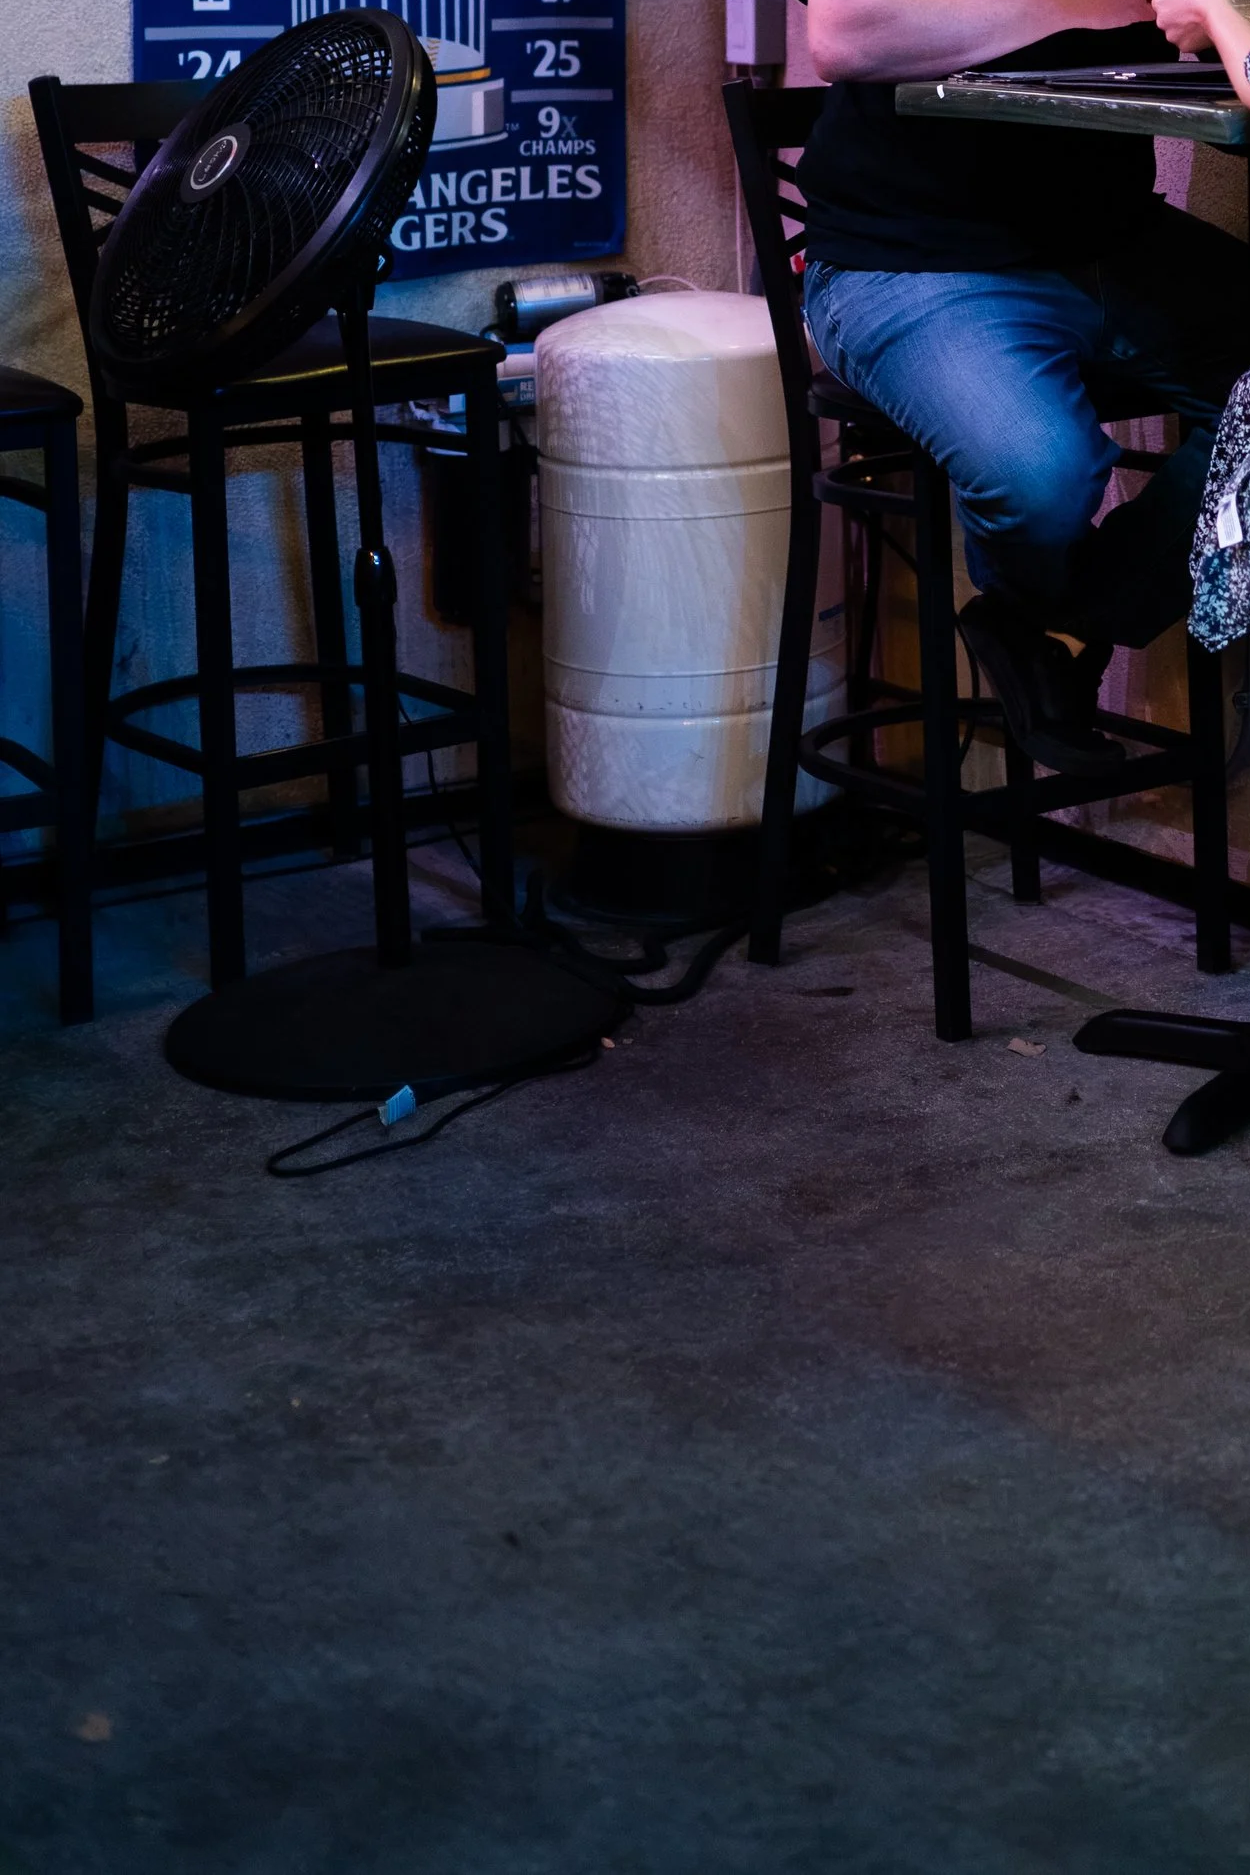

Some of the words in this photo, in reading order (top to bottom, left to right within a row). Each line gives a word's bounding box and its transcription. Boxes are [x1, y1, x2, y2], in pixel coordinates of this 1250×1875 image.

[526, 39, 581, 77] '25
[519, 139, 597, 156] CHAMPS
[407, 164, 603, 209] ANGELES
